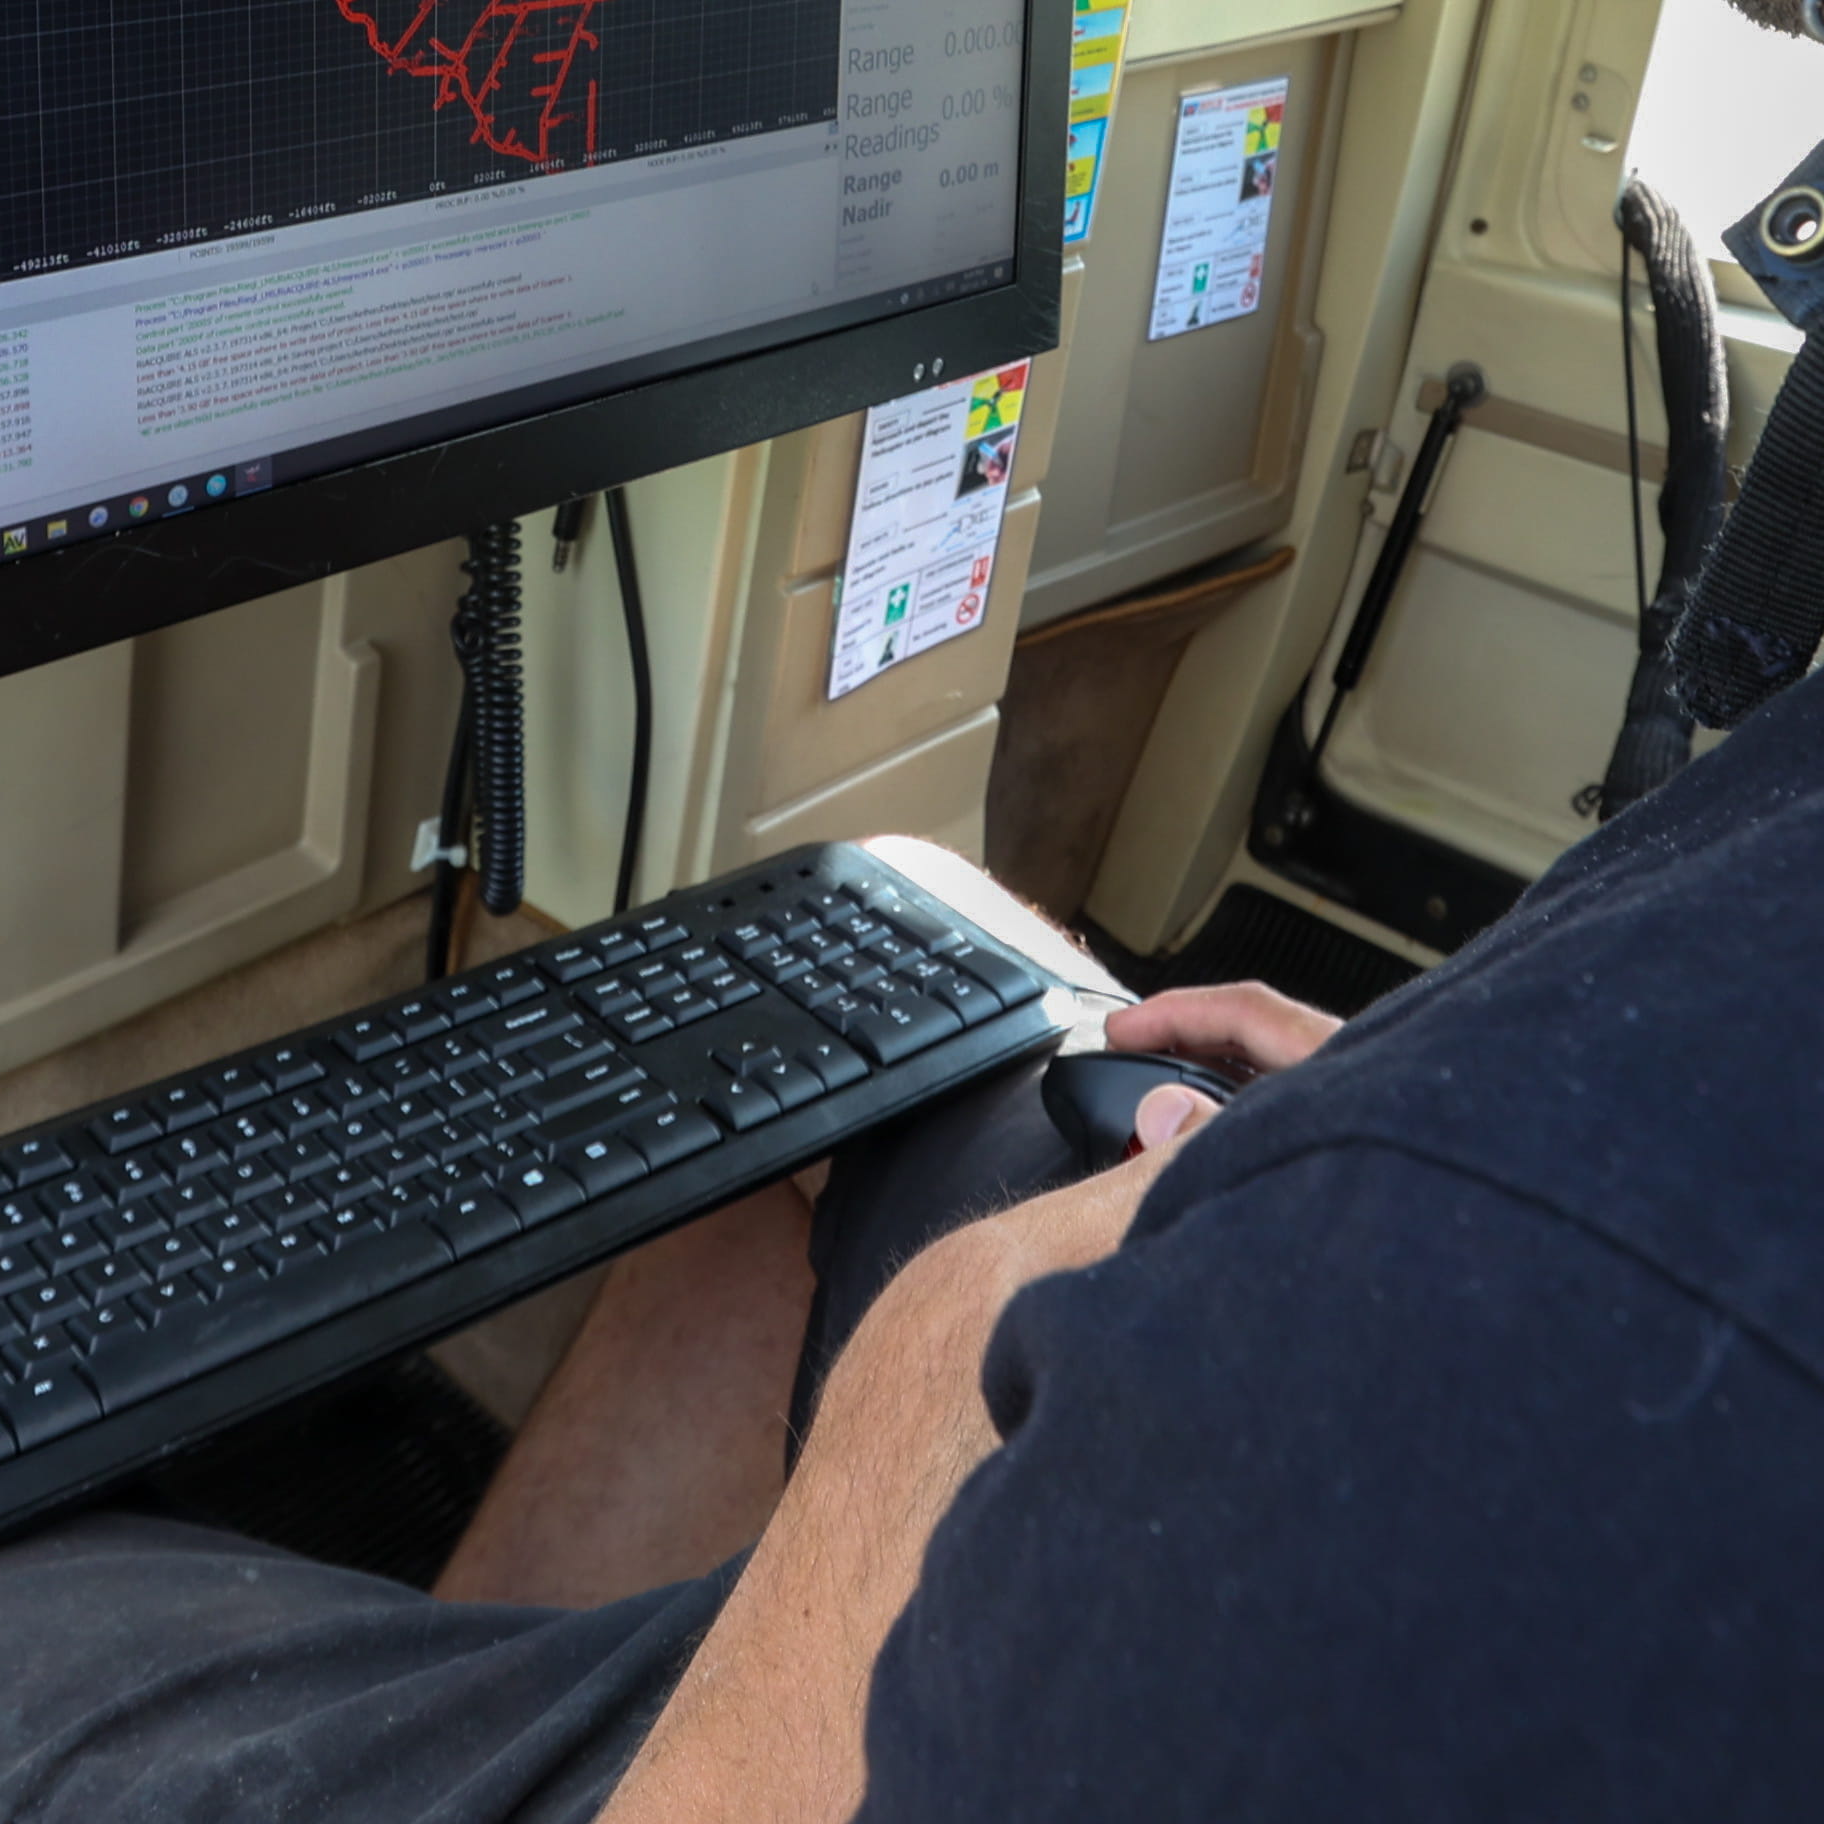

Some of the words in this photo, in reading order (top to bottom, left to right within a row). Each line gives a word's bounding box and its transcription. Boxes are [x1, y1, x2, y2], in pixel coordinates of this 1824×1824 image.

[847, 42, 915, 75] Range
[846, 87, 914, 121] Range
[942, 88, 985, 121] 0.00
[991, 84, 1014, 108] %
[844, 121, 940, 160] Readings
[843, 167, 903, 196] Range
[938, 162, 978, 188] 0.00
[983, 161, 1000, 178] m
[842, 198, 894, 227] Nadir
[189, 244, 222, 260] POINTS:
[135, 302, 167, 313] Process
[136, 315, 167, 328] Process
[136, 344, 156, 356] Data
[137, 373, 155, 384] Less
[157, 368, 175, 379] than
